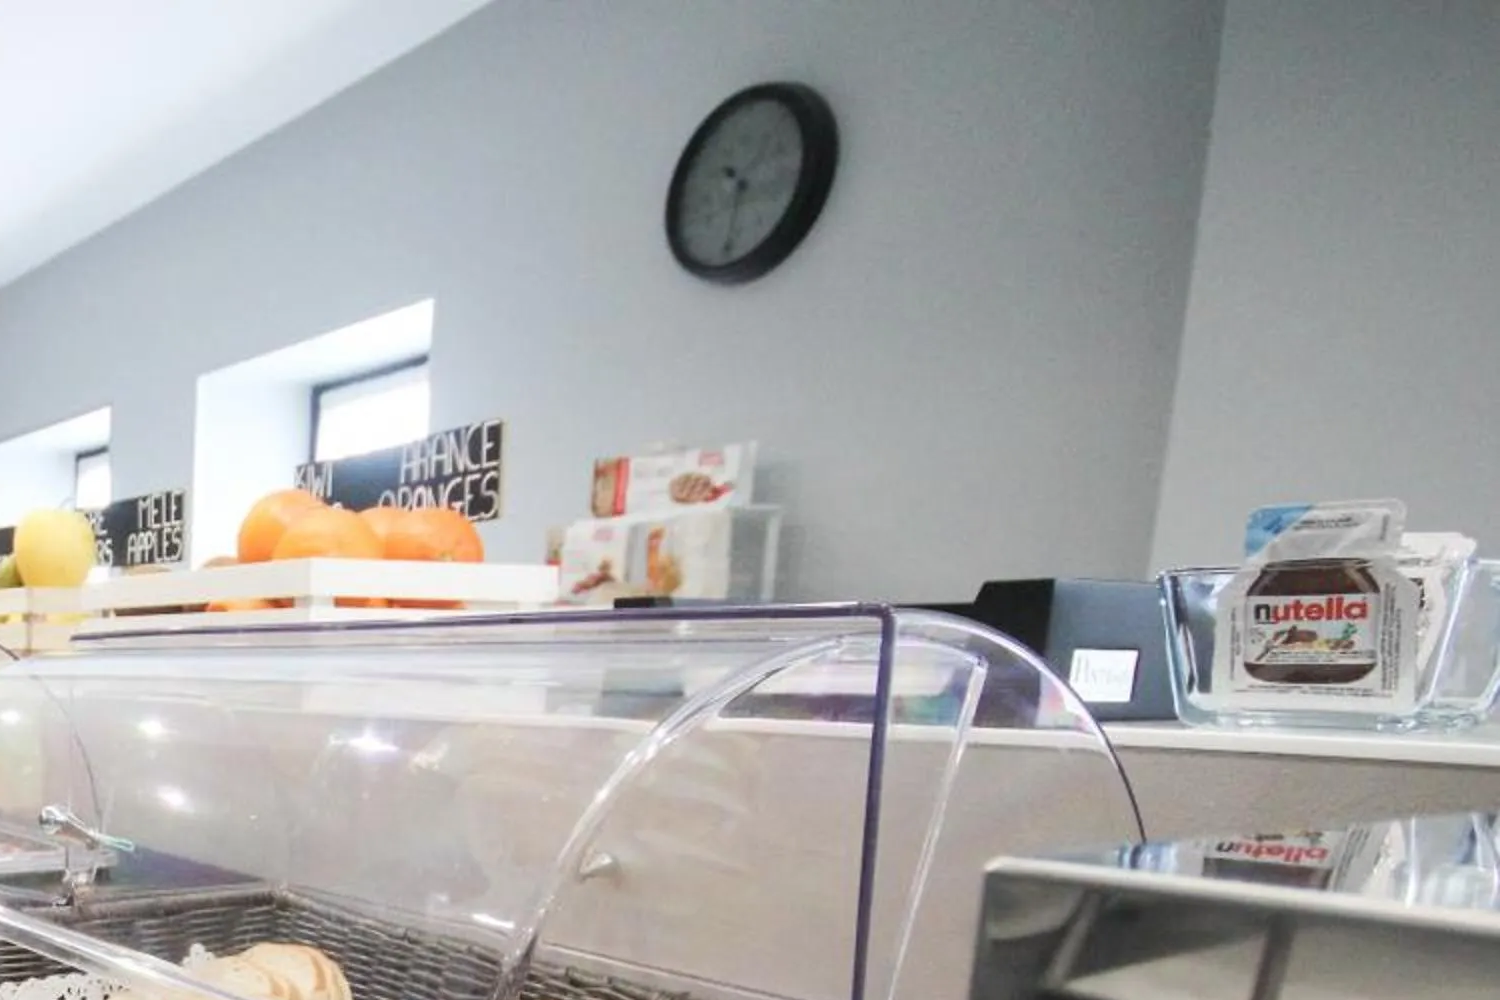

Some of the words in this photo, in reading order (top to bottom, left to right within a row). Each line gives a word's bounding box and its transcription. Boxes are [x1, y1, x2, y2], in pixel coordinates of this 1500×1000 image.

[138, 491, 184, 530] MELE
[126, 526, 184, 564] APPLES
[1254, 597, 1367, 624] nutella
